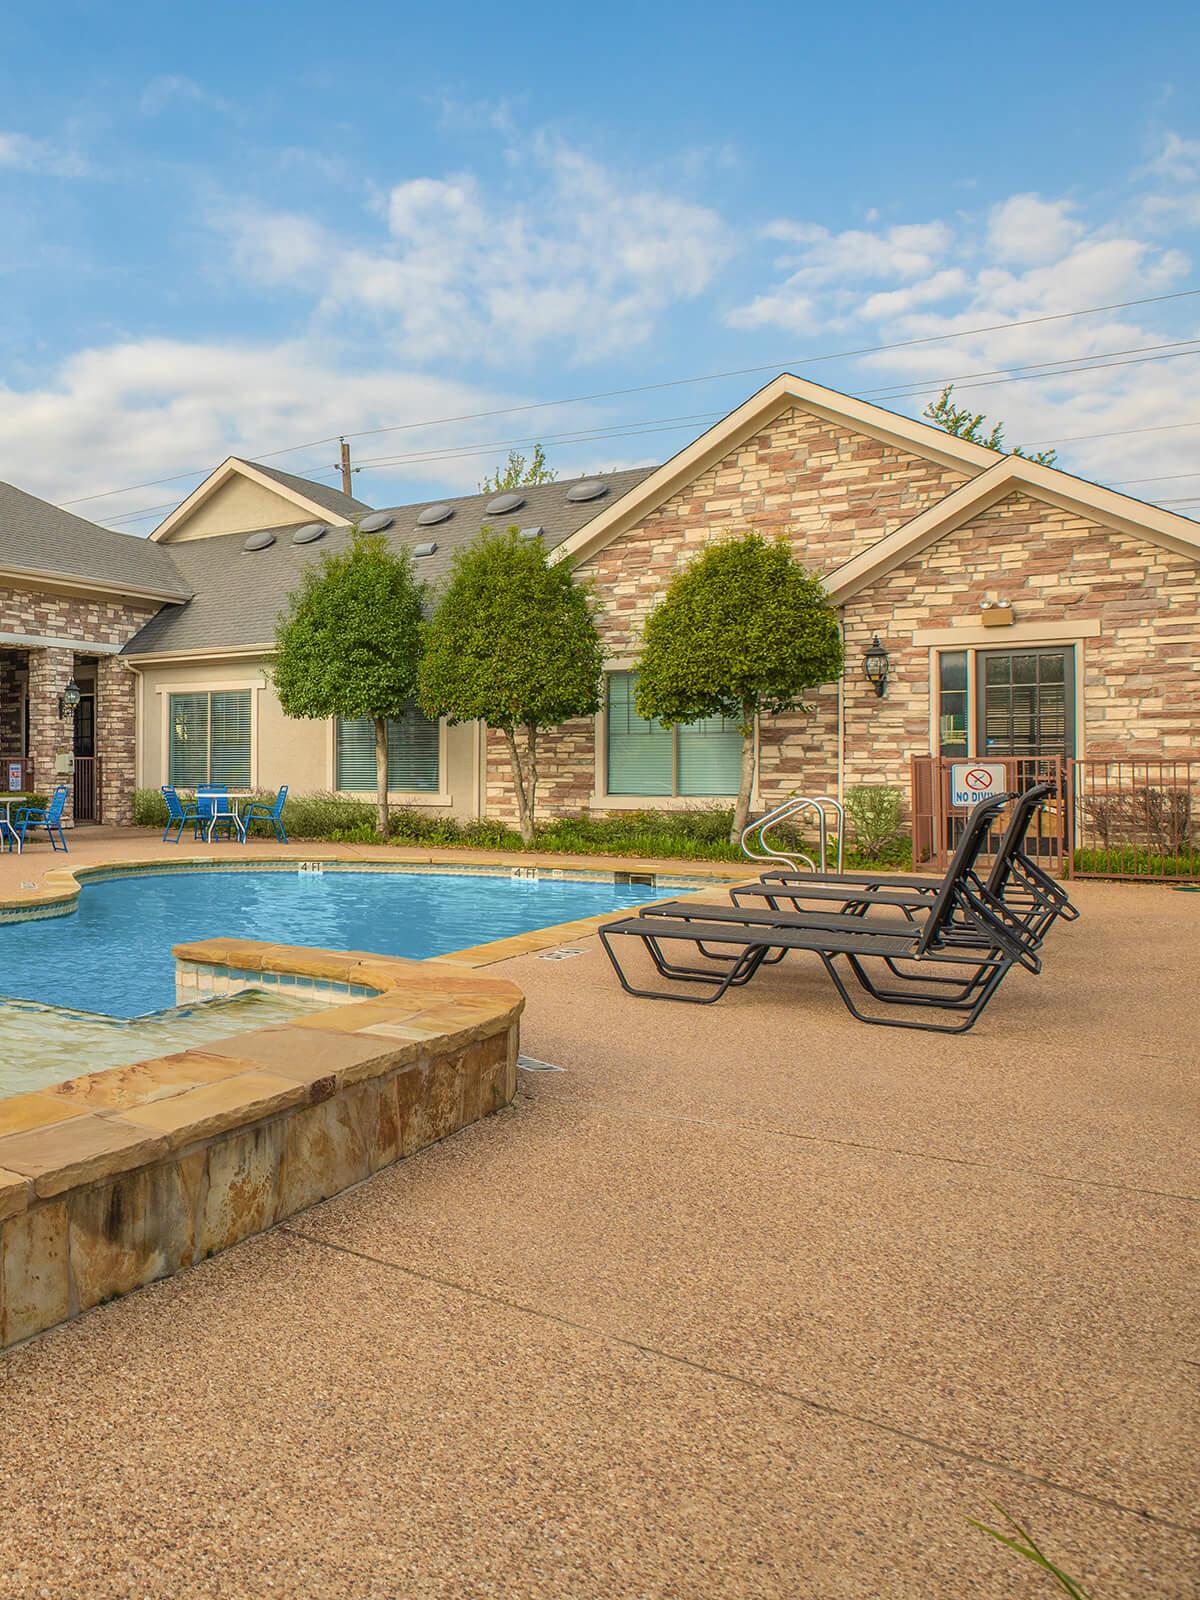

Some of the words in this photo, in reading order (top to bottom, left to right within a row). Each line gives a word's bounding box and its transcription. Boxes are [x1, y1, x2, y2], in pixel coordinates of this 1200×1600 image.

[956, 792, 968, 801] NO
[300, 862, 307, 871] 4
[311, 862, 321, 872] FT
[514, 868, 520, 877] 4
[526, 868, 536, 878] FT
